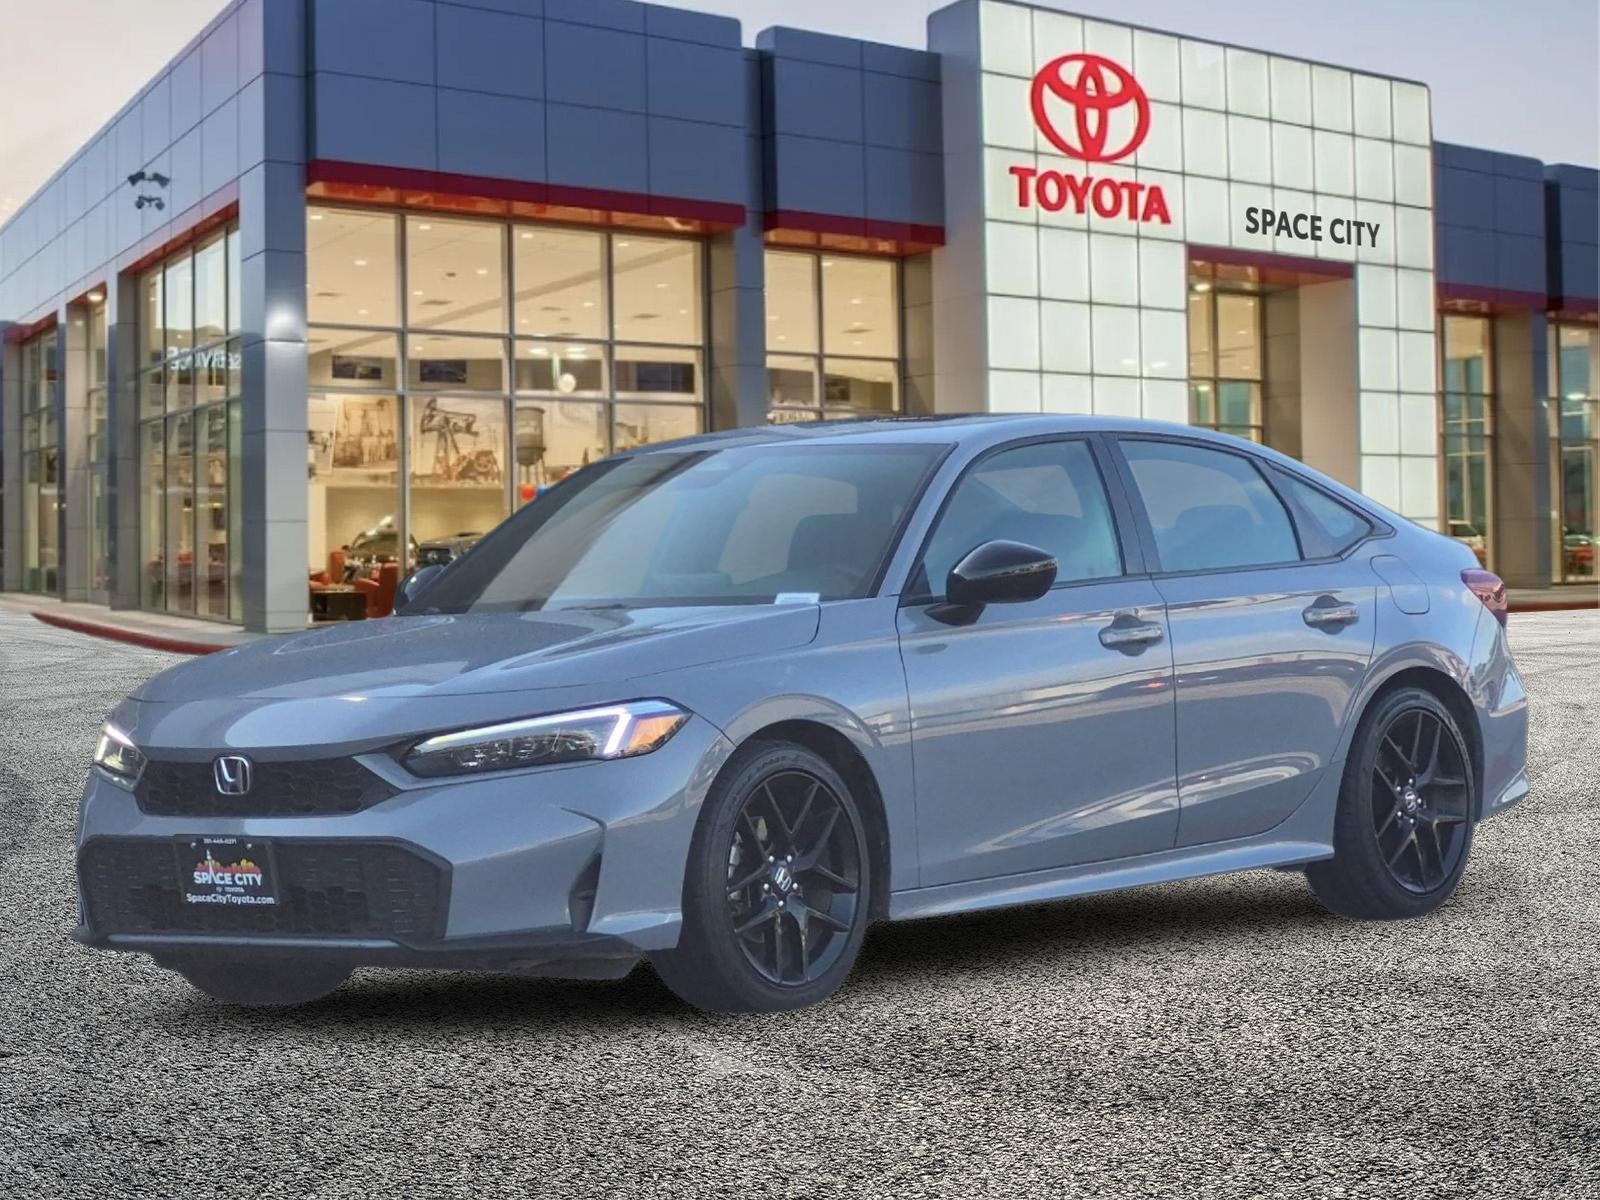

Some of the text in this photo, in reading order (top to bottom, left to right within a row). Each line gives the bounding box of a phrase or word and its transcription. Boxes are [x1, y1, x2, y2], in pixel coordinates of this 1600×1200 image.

[1009, 166, 1171, 224] TOYOTA
[1245, 207, 1381, 248] SPACE CITY
[193, 871, 262, 886] SPACE CITY
[186, 893, 275, 905] SpaceCityToyota.com
